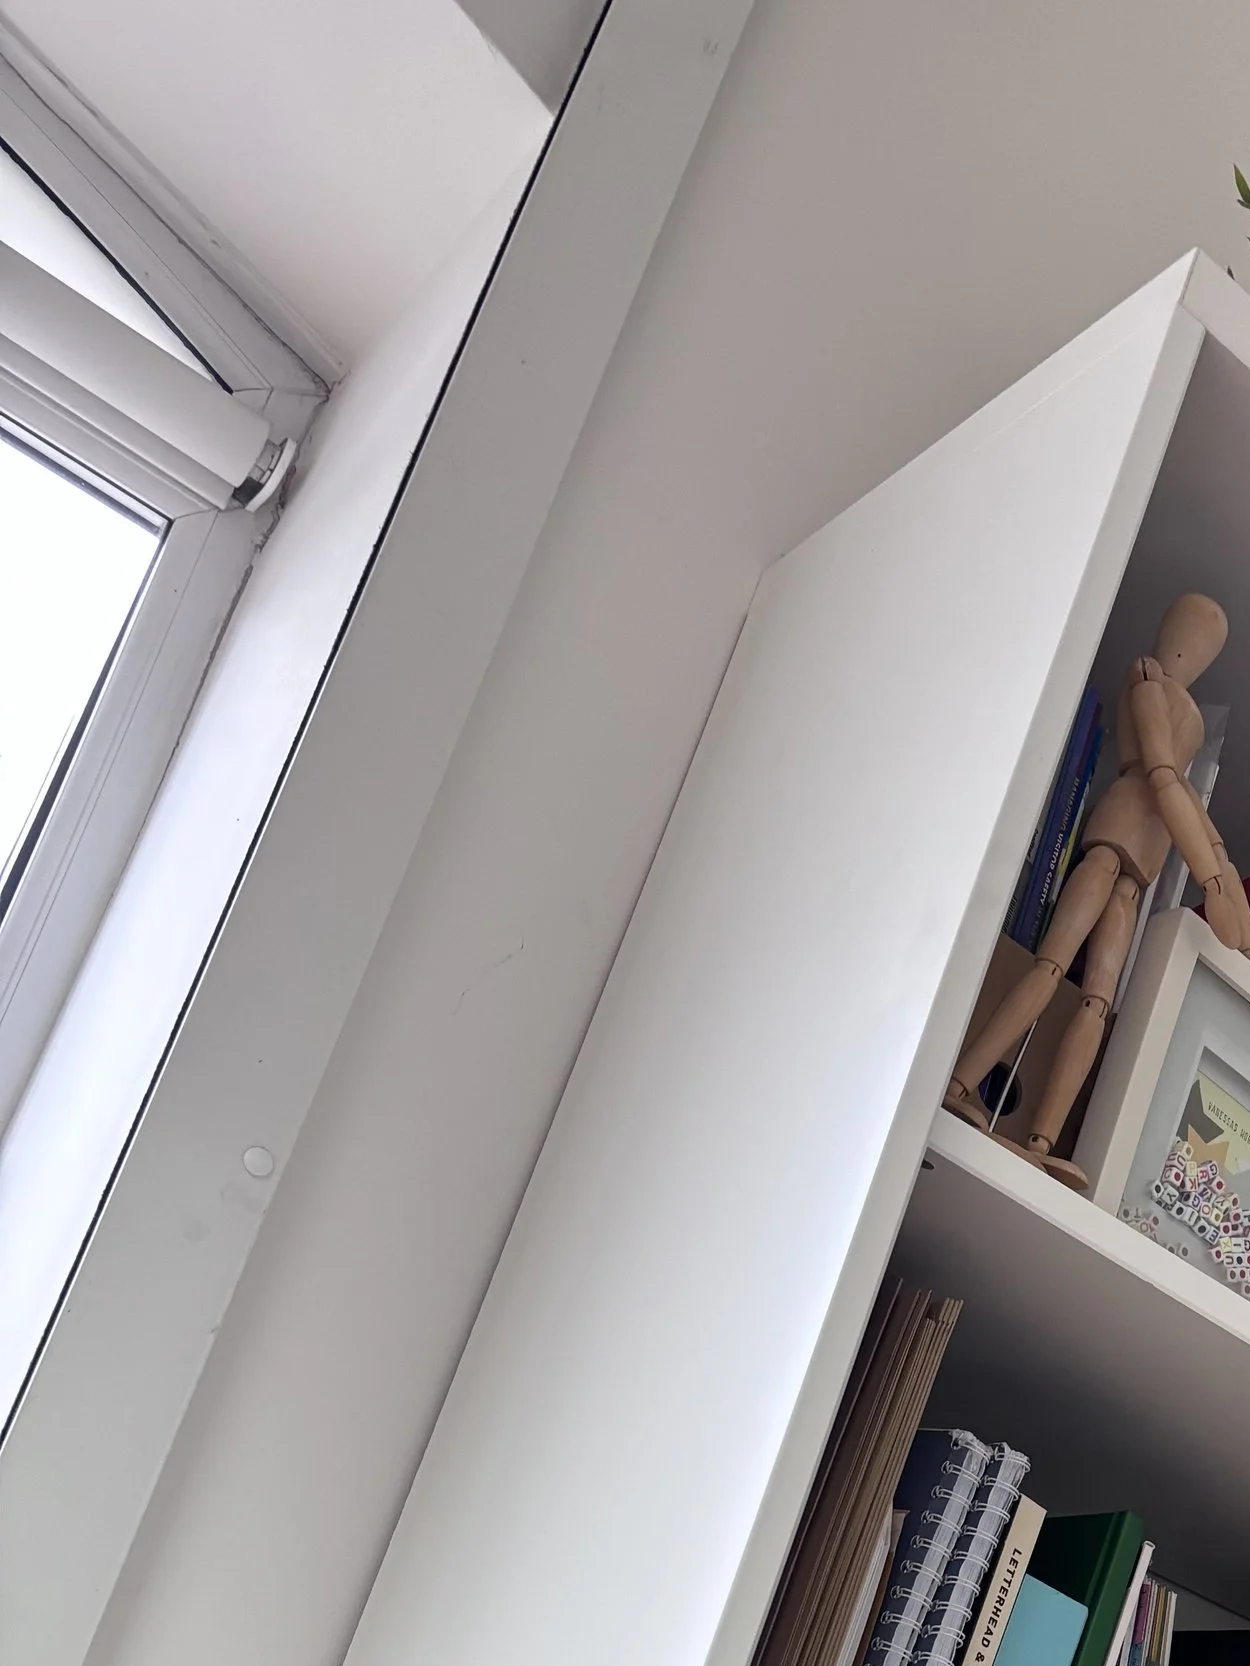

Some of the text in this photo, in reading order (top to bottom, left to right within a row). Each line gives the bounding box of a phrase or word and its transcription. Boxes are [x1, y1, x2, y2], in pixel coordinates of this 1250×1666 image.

[1207, 1101, 1240, 1132] VANESSAS
[981, 1548, 1021, 1647] LETTERHEAD
[976, 1652, 984, 1661] &
